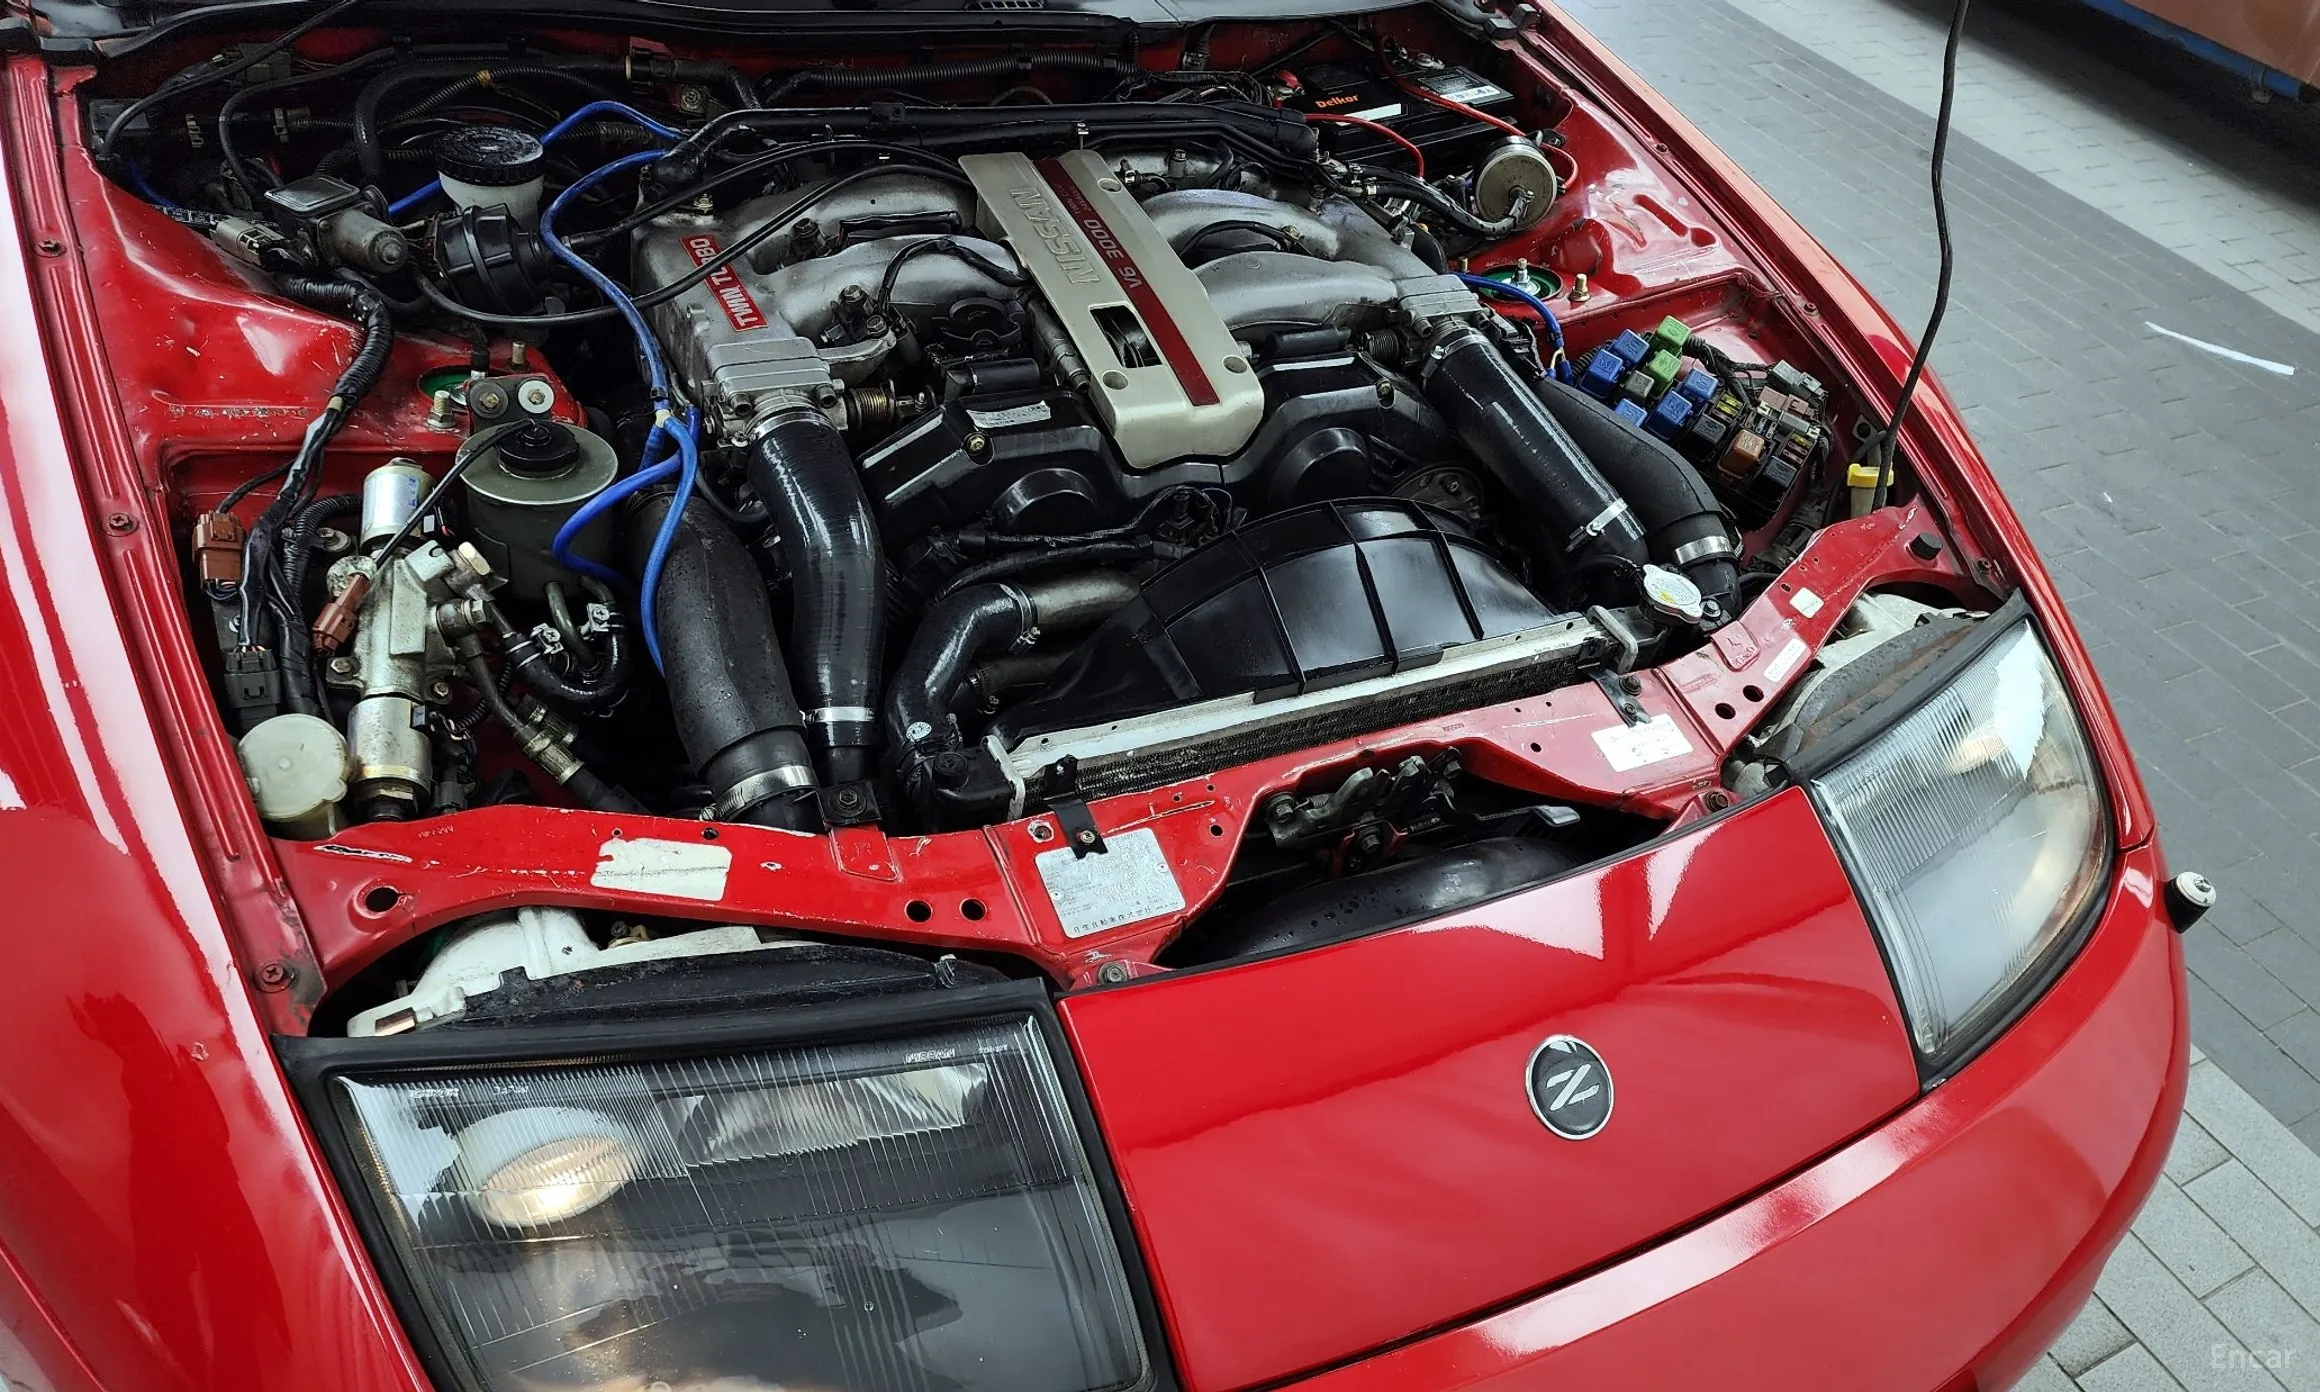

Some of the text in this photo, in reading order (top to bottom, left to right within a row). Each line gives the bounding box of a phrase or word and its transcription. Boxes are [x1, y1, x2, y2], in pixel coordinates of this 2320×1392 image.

[1315, 95, 1359, 108] Delkor
[1009, 187, 1100, 284] NISSAN
[1083, 219, 1142, 289] V6 3000
[719, 285, 759, 327] TWIN
